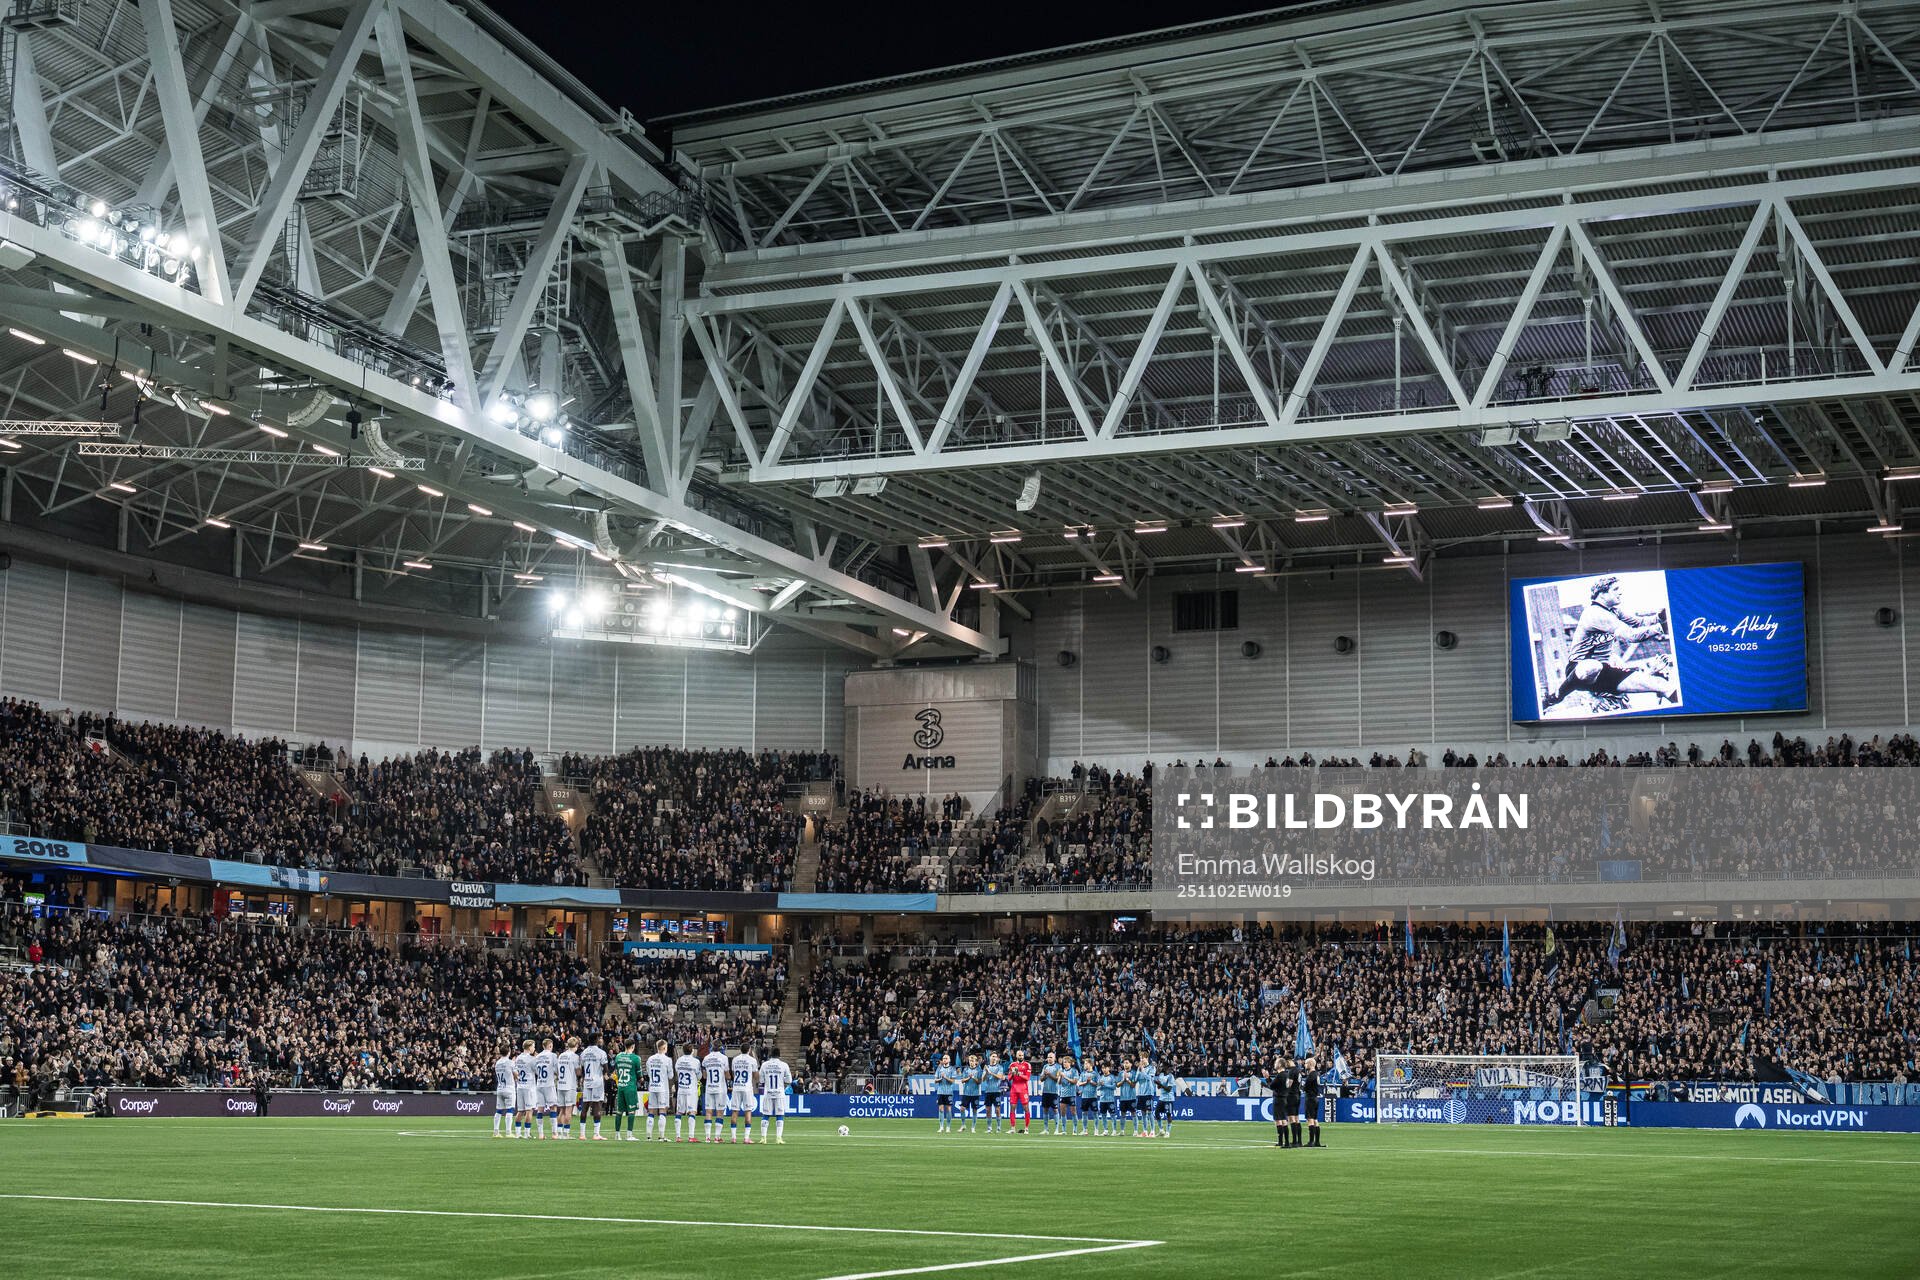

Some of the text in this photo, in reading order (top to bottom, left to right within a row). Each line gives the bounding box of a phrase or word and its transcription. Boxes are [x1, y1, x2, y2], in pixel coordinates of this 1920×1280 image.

[1686, 614, 1778, 643] Björn Alkeby
[1708, 642, 1758, 652] 1952-2025
[913, 708, 944, 749] 3
[903, 753, 956, 770] Arena
[13, 839, 70, 858] 2018
[451, 883, 486, 894] CURVA
[559, 1066, 566, 1079] 9
[618, 1068, 631, 1083] 25
[650, 1069, 661, 1084] 15
[678, 1072, 692, 1086] 23
[708, 1069, 720, 1084] 13
[734, 1070, 749, 1084] 29
[769, 1074, 778, 1089] 11
[849, 1095, 915, 1104] STOCKHOLMS
[1727, 1088, 1760, 1104] MOT
[1762, 1088, 1805, 1104] ASEN
[120, 1098, 155, 1113] Corpay
[227, 1098, 257, 1112] Corpay
[323, 1100, 352, 1112] Corpay
[373, 1100, 400, 1112] Corpay
[456, 1100, 481, 1112] Corpay
[1604, 1099, 1612, 1126] SELECT
[1776, 1109, 1864, 1126] NordVPN
